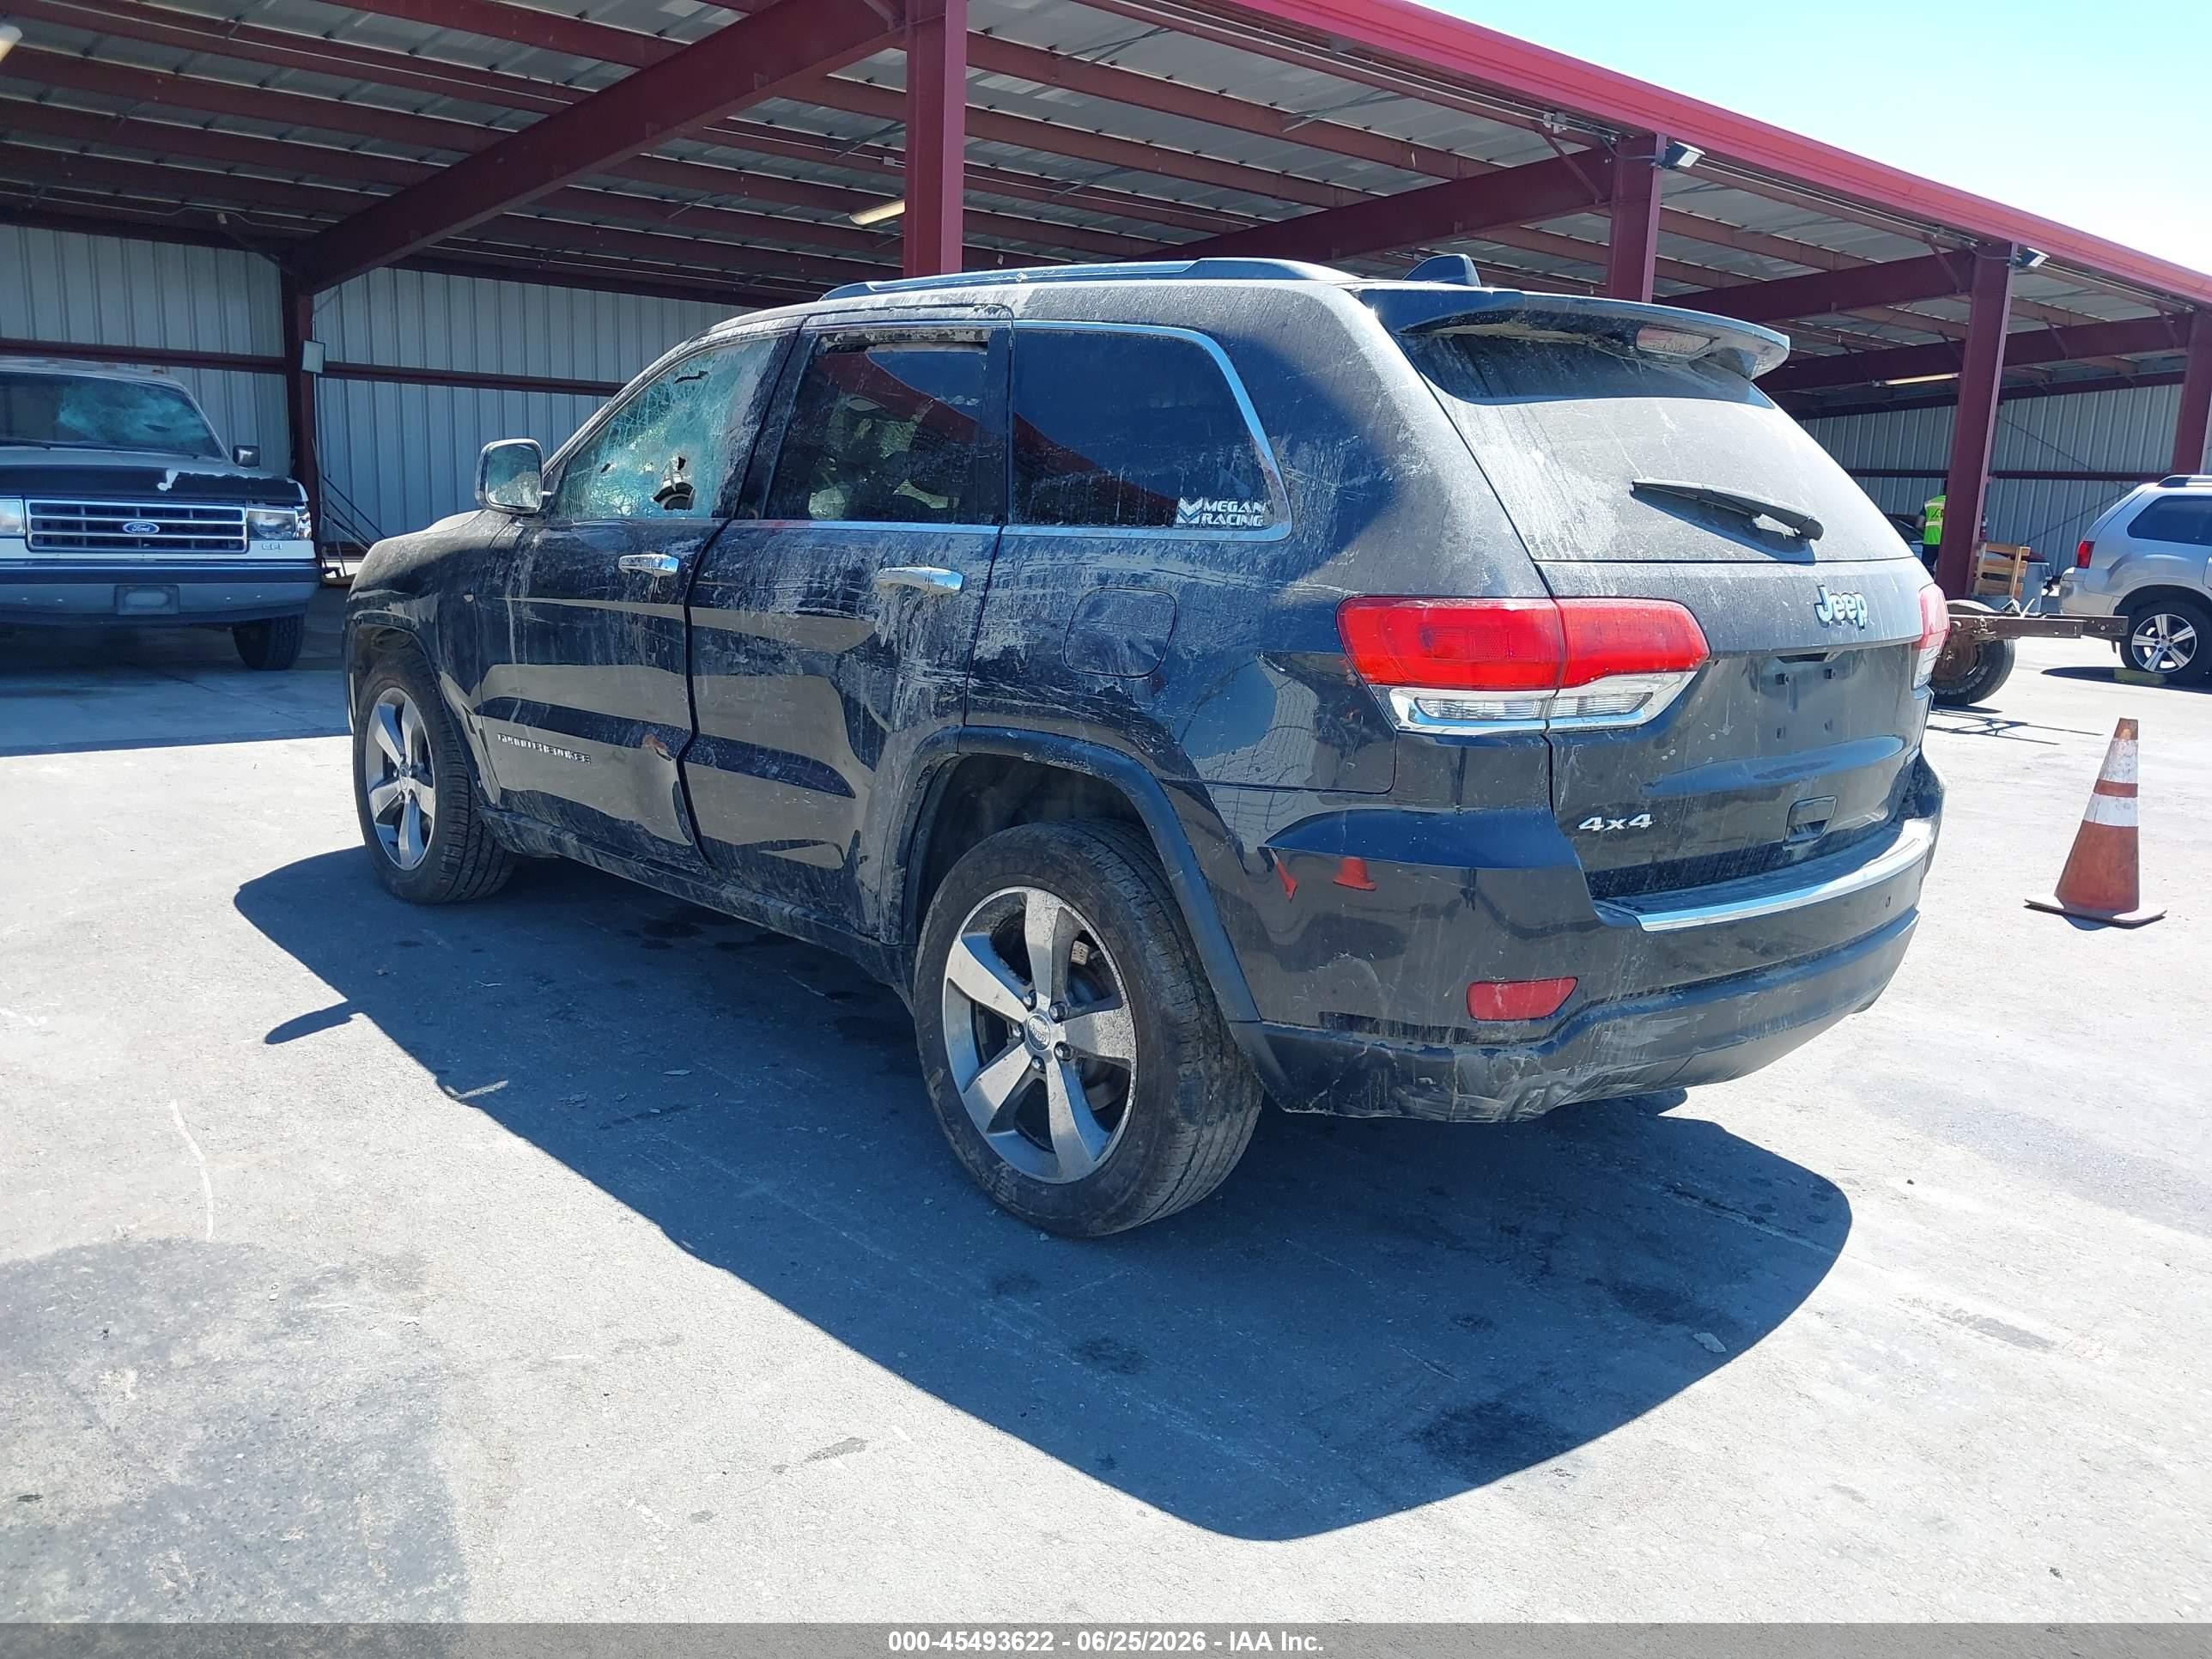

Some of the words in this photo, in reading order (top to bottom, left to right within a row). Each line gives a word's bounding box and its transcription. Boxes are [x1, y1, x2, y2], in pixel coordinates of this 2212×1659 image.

[1203, 501, 1266, 513] MEGAN
[1202, 513, 1264, 526] RACING
[1814, 585, 1869, 630] Jeep
[1577, 813, 1653, 831] 4x4
